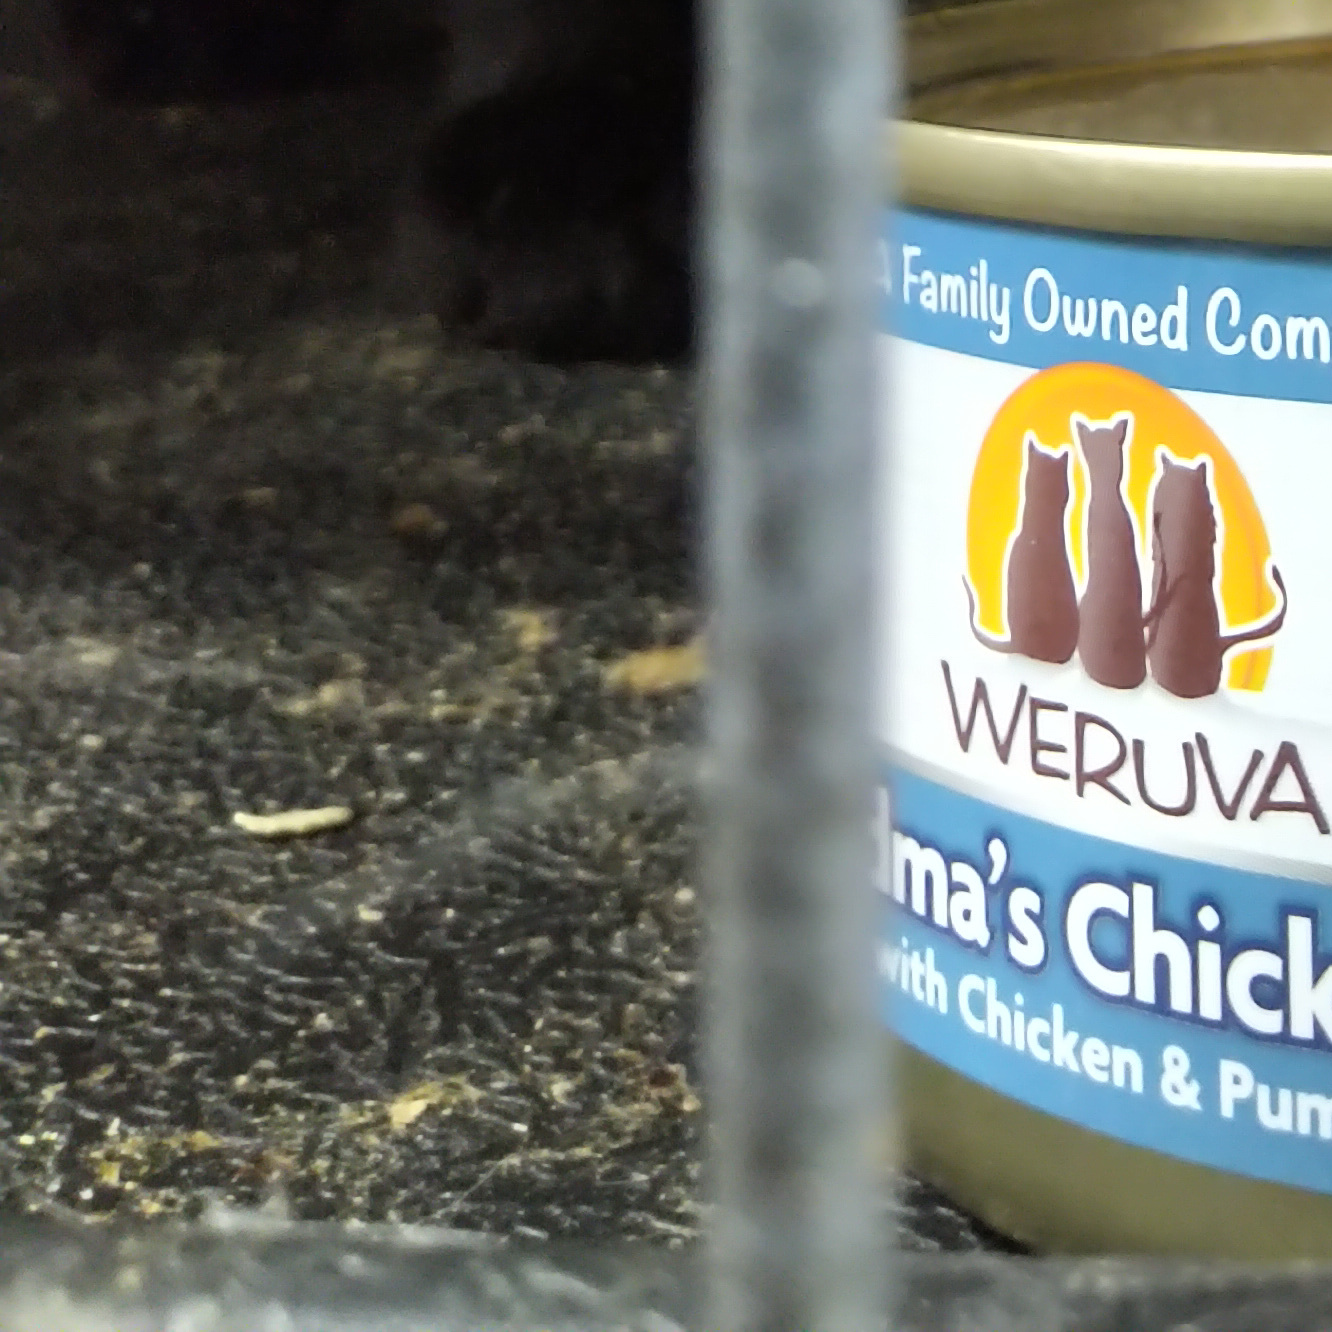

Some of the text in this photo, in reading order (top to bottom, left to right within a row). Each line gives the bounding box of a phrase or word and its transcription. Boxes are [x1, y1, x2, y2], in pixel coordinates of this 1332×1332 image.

[902, 243, 1010, 344] Family
[1024, 268, 1188, 352] Owned
[940, 659, 1331, 835] WERUVA
[958, 974, 1144, 1094] Chicken
[1160, 1044, 1202, 1112] &
